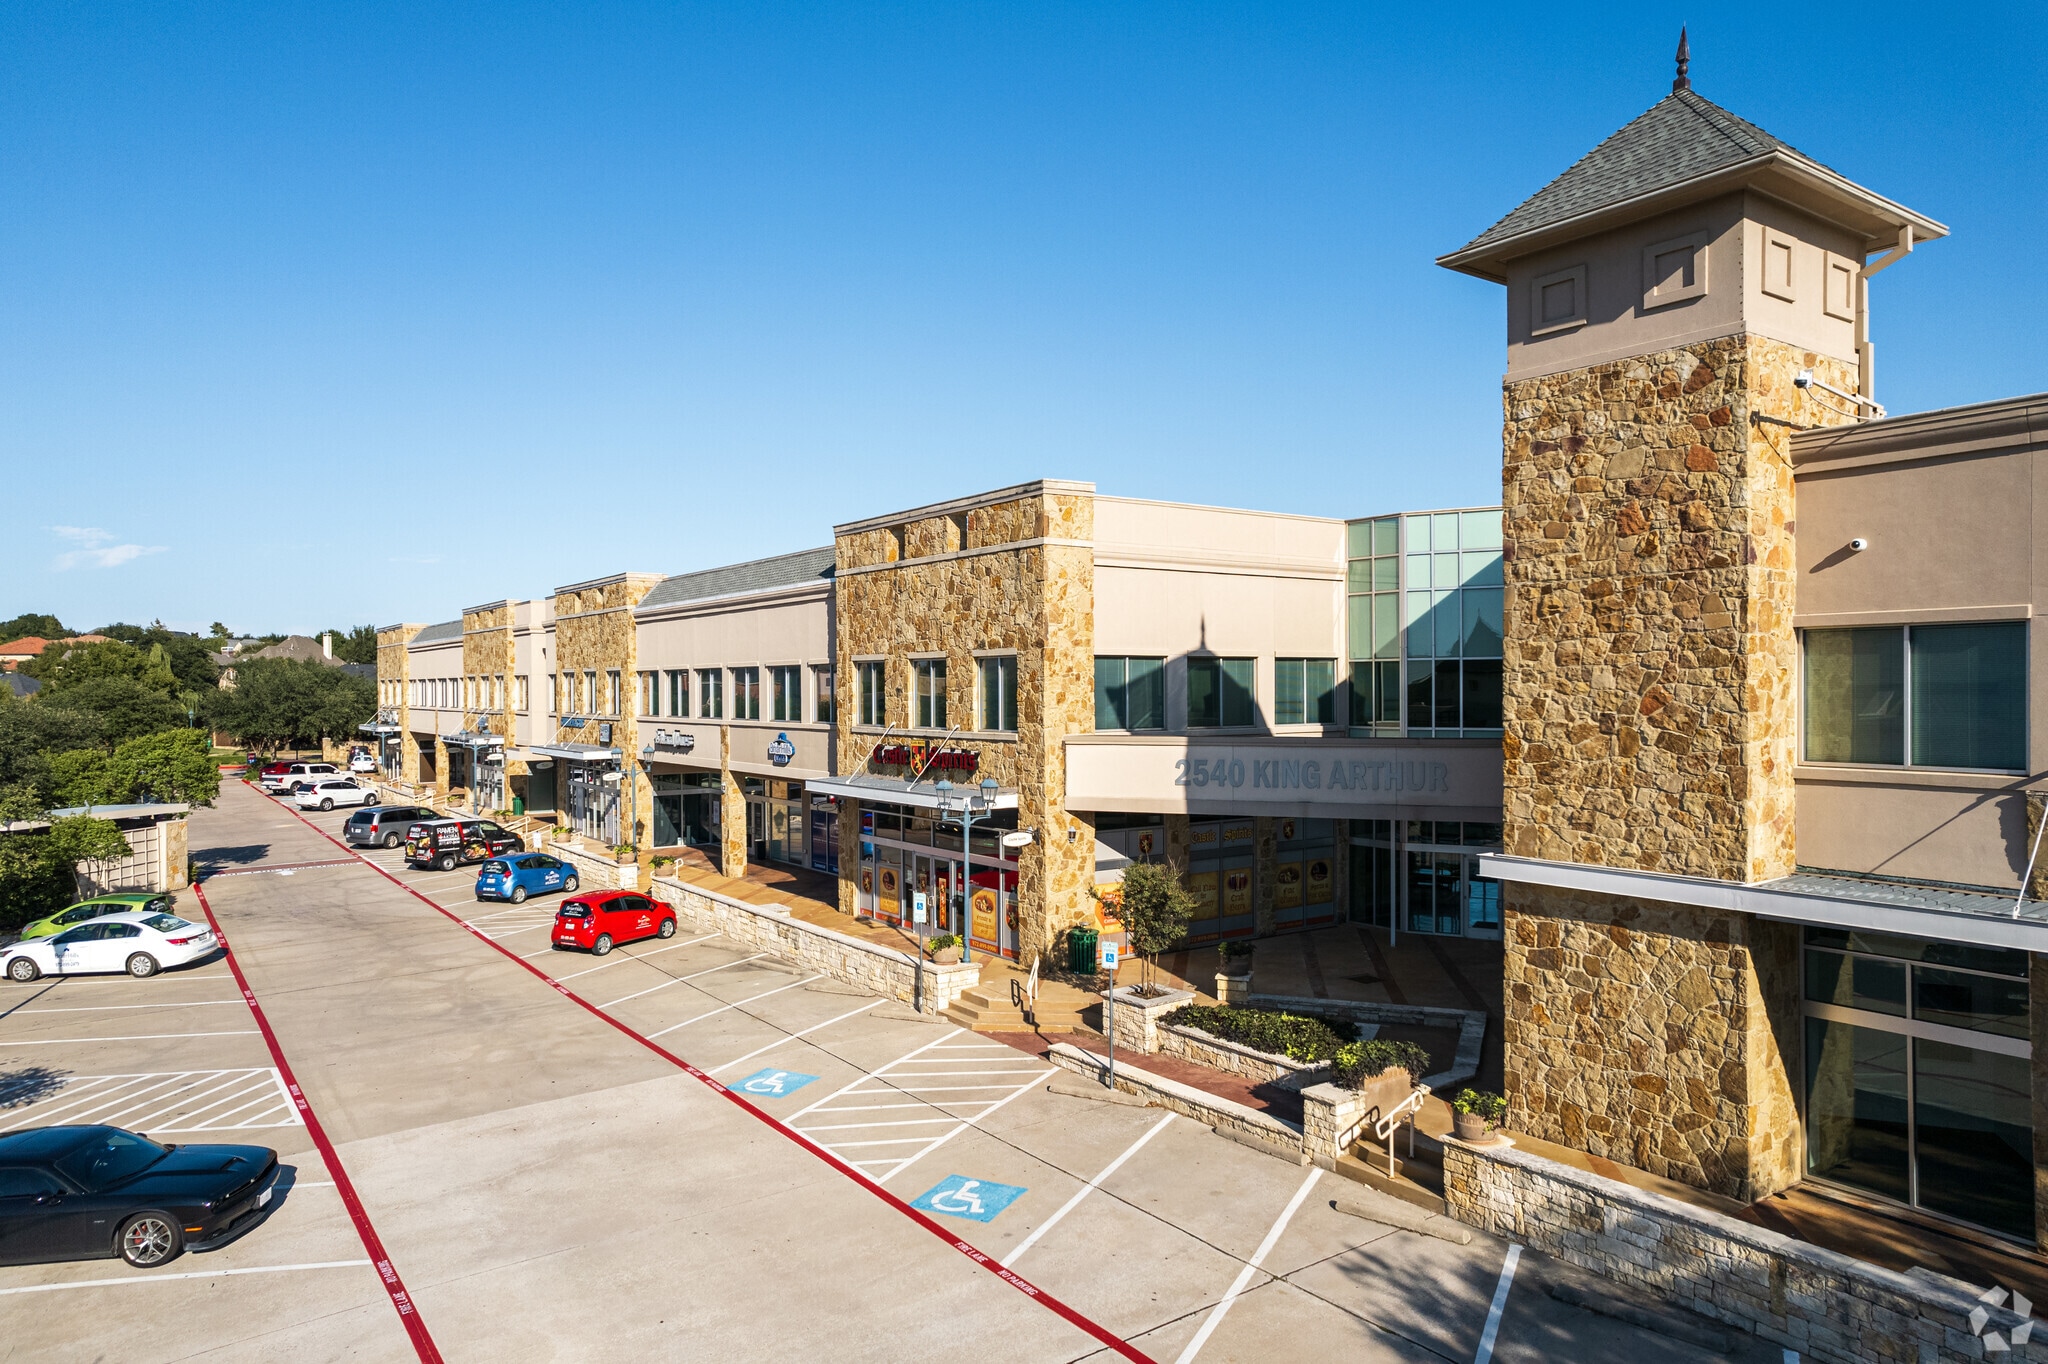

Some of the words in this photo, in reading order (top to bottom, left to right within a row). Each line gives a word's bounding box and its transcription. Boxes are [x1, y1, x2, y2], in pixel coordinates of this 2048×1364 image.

[873, 744, 908, 765] Castle
[928, 746, 976, 772] Spirits
[1174, 758, 1245, 788] 2540
[1253, 759, 1321, 789] KING
[1327, 760, 1448, 792] ARTHUR
[1192, 831, 1216, 843] Castle
[1224, 827, 1253, 842] Spirits
[954, 1242, 972, 1253] FIRE
[967, 1248, 988, 1263] LANE
[997, 1269, 1011, 1278] NO
[1009, 1276, 1038, 1296] PARKING
